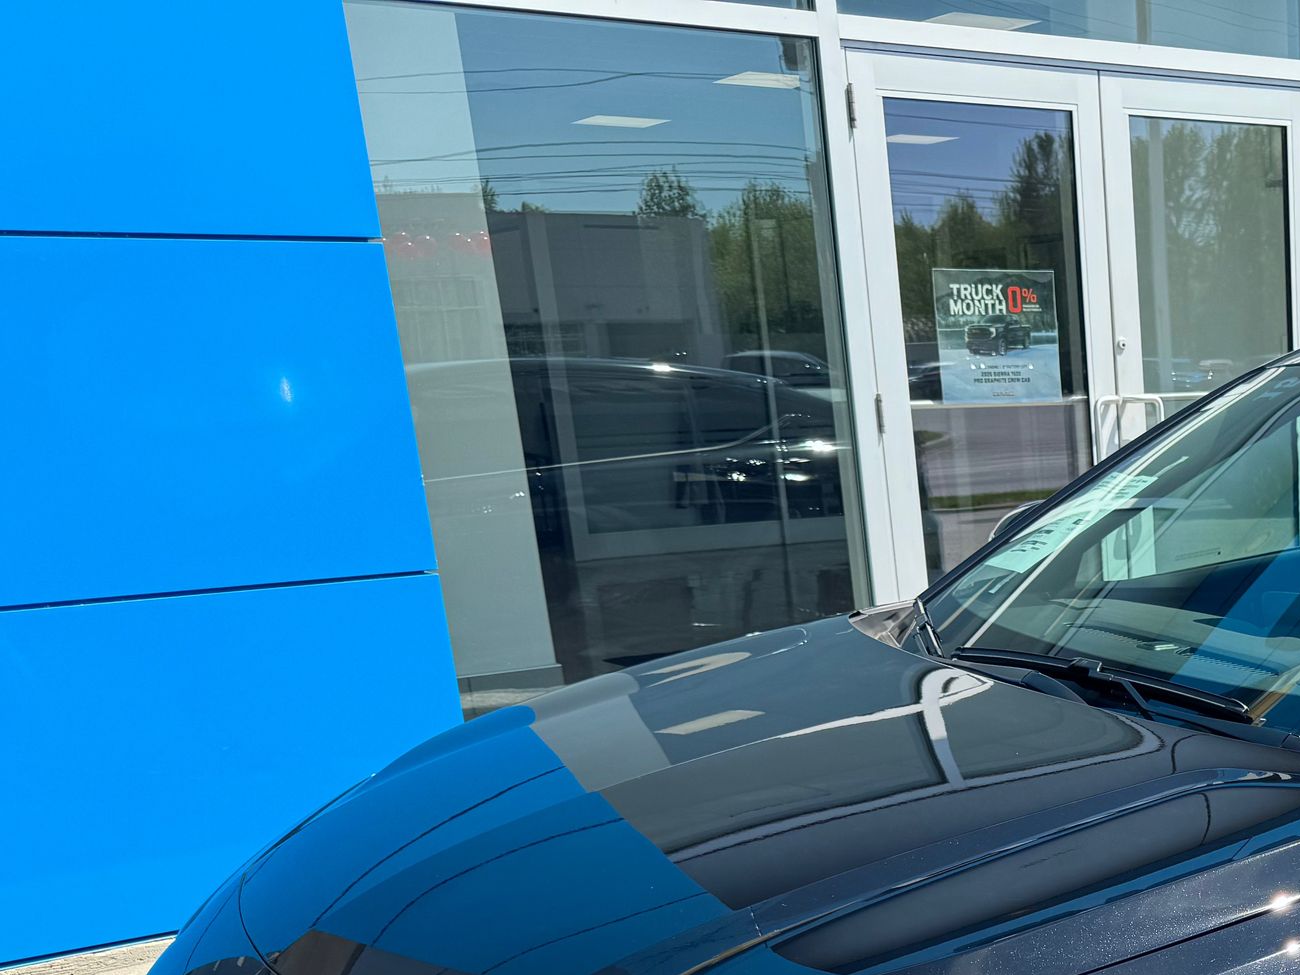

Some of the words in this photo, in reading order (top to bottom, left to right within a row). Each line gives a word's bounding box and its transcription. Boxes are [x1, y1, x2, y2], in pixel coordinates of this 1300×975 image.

[949, 284, 1004, 300] TRUCK
[1007, 286, 1038, 313] 0%
[950, 299, 1007, 315] MONTH
